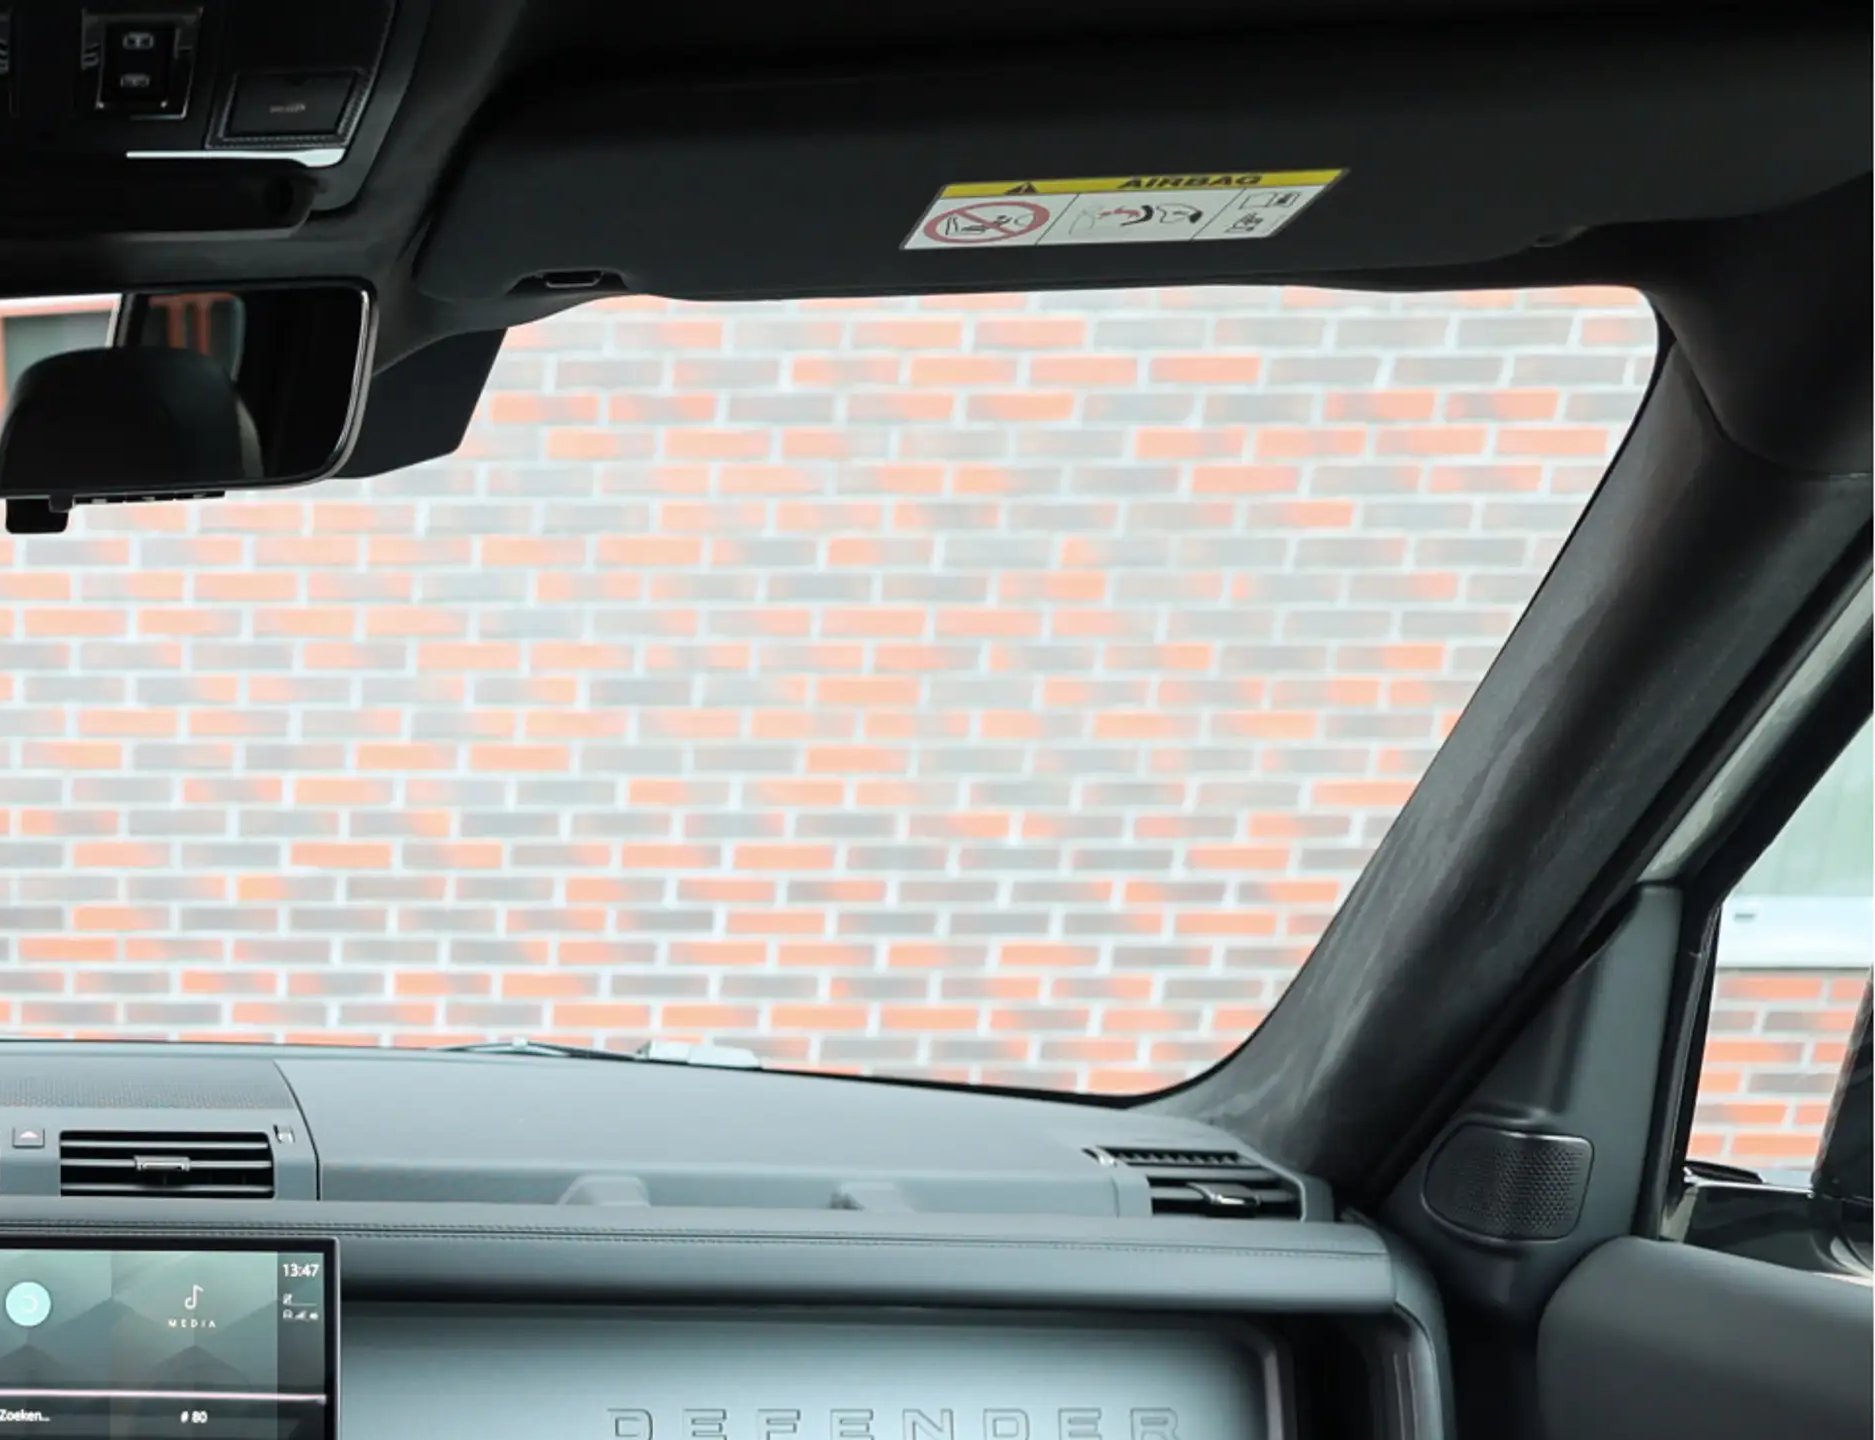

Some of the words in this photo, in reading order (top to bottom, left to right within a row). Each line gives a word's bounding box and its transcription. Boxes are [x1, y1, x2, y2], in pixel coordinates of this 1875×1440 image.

[1118, 175, 1262, 189] AIRBAG
[282, 1263, 320, 1277] 13:47
[168, 1319, 216, 1328] MEDIA
[191, 1410, 208, 1423] 80
